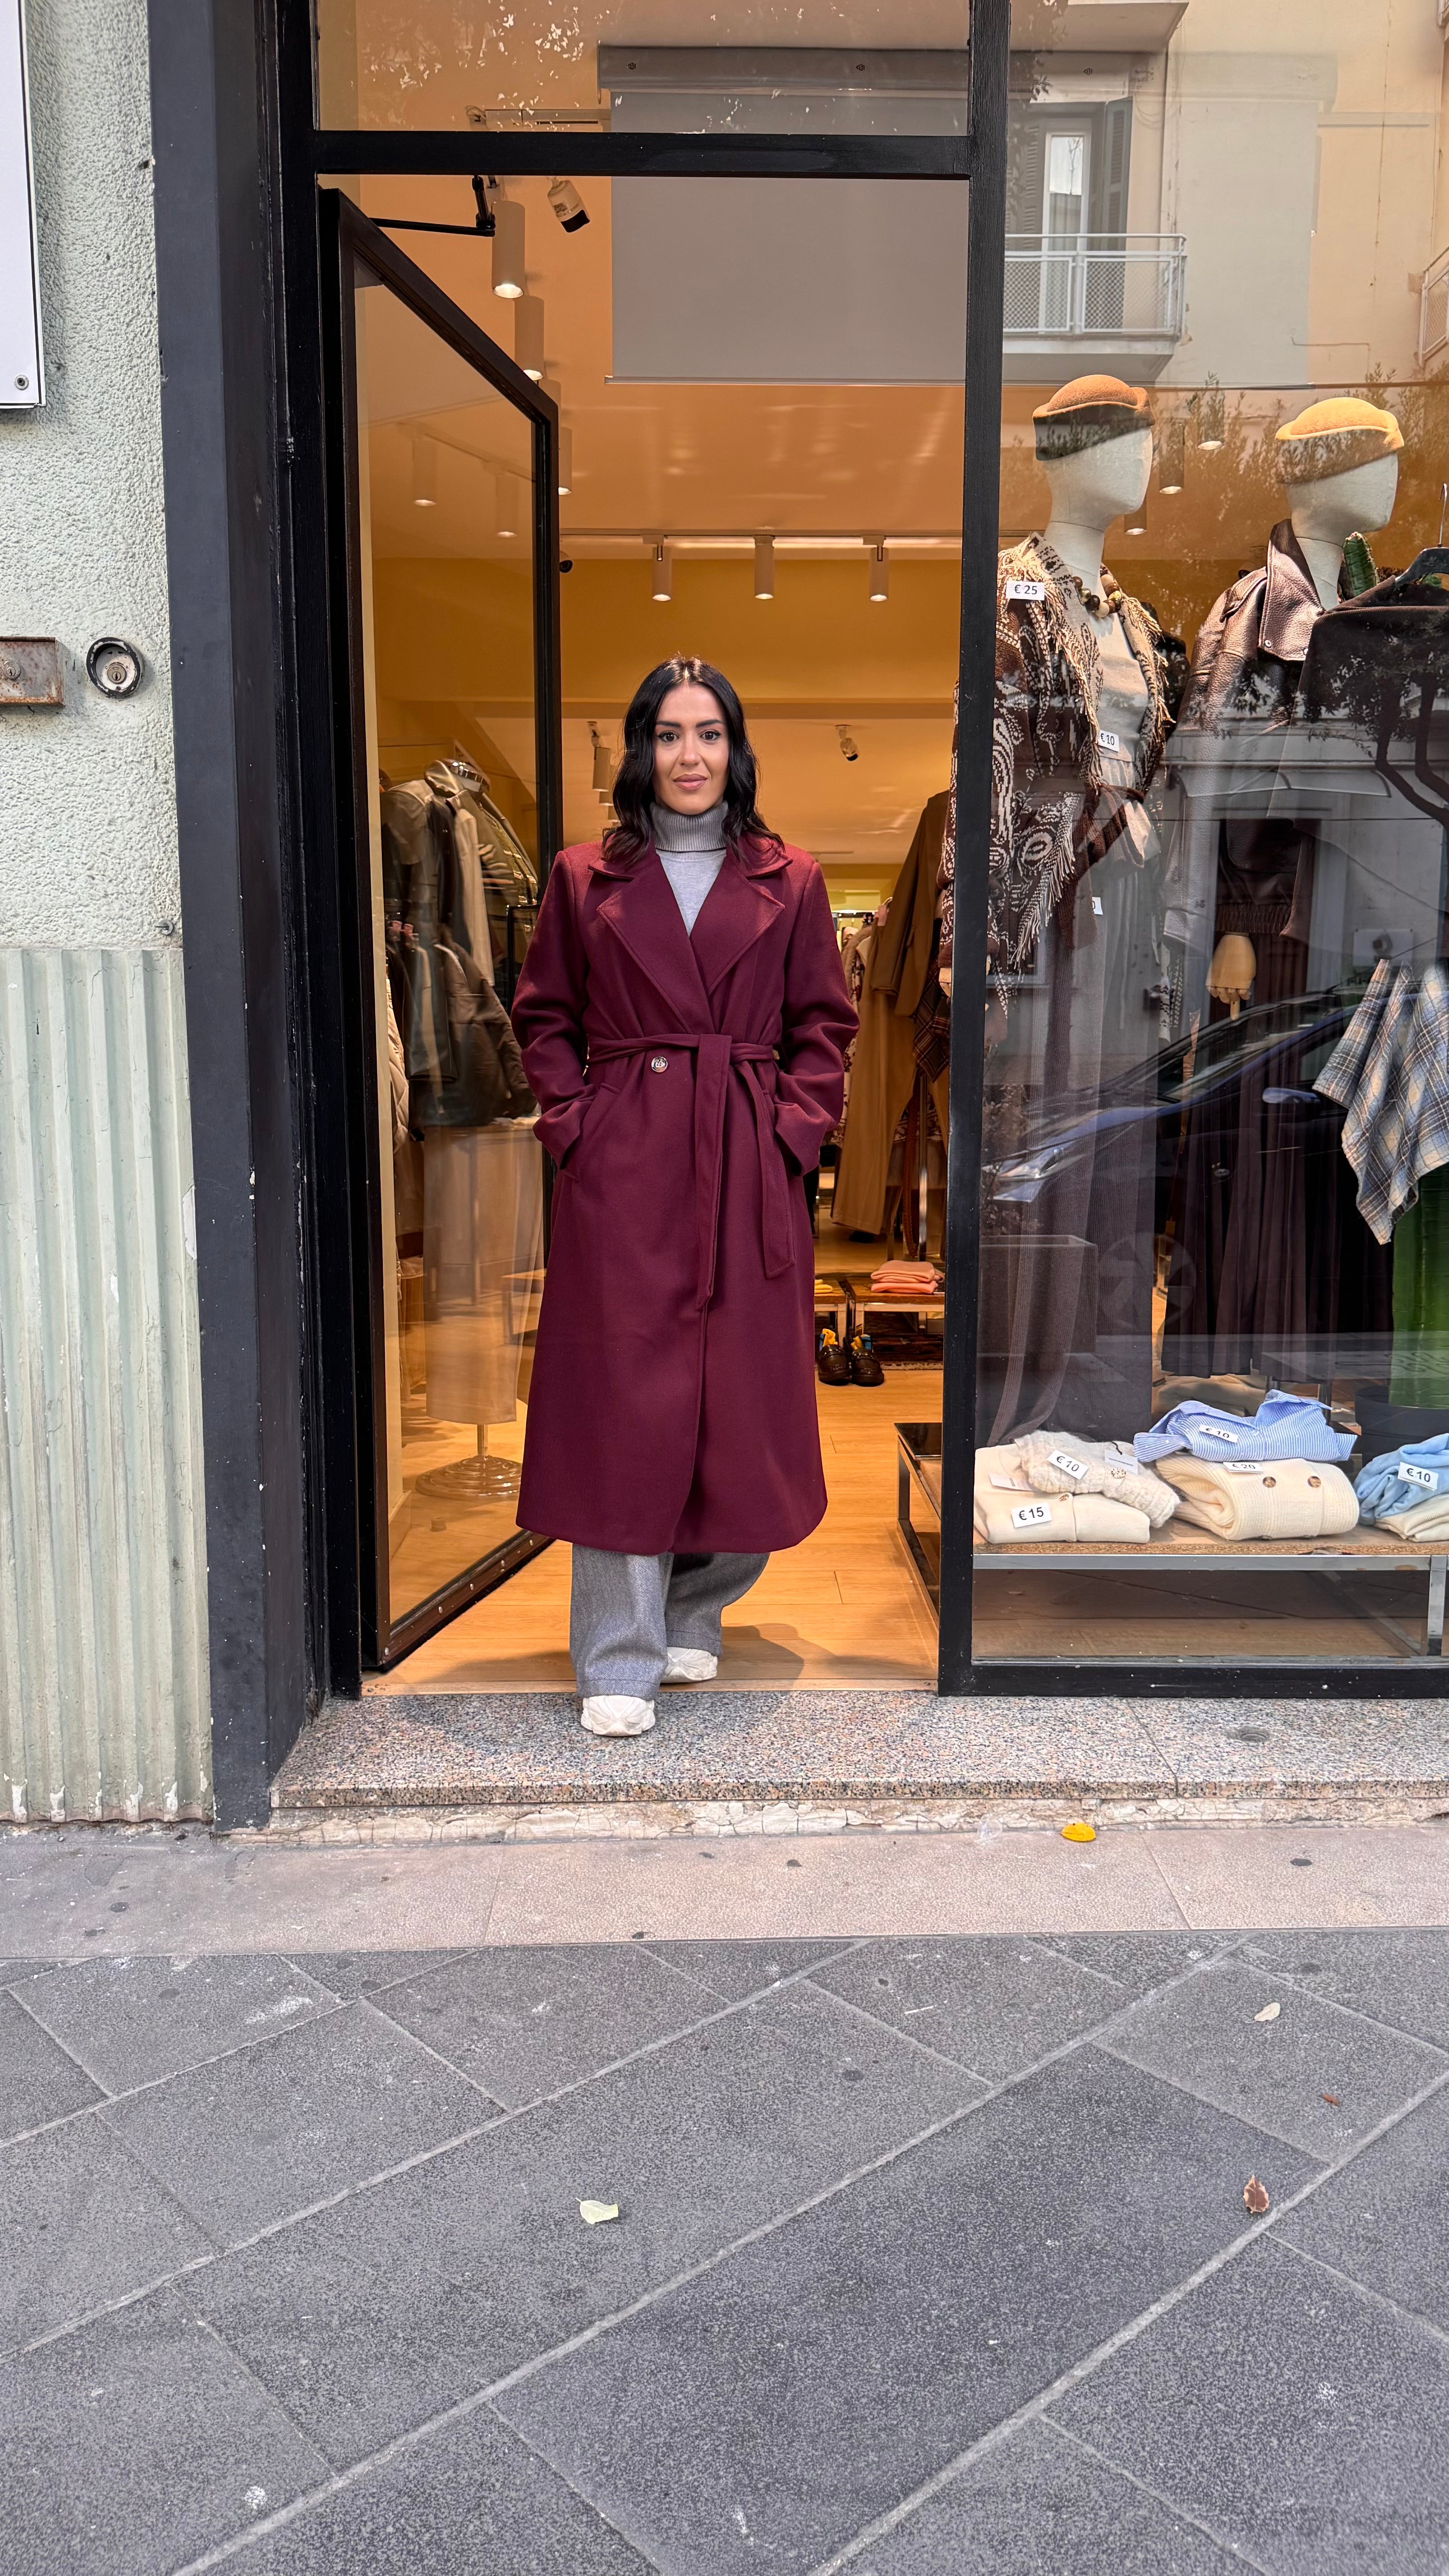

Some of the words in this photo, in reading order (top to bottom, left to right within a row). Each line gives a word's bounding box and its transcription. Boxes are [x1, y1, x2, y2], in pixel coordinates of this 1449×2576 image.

[1014, 584, 1021, 593] €
[1024, 585, 1037, 594] 25
[1106, 735, 1114, 745] 10
[1067, 1461, 1079, 1472] 10
[1407, 1468, 1414, 1477] €
[1417, 1471, 1431, 1482] 10
[1019, 1510, 1027, 1520] €
[1029, 1507, 1044, 1518] 15
